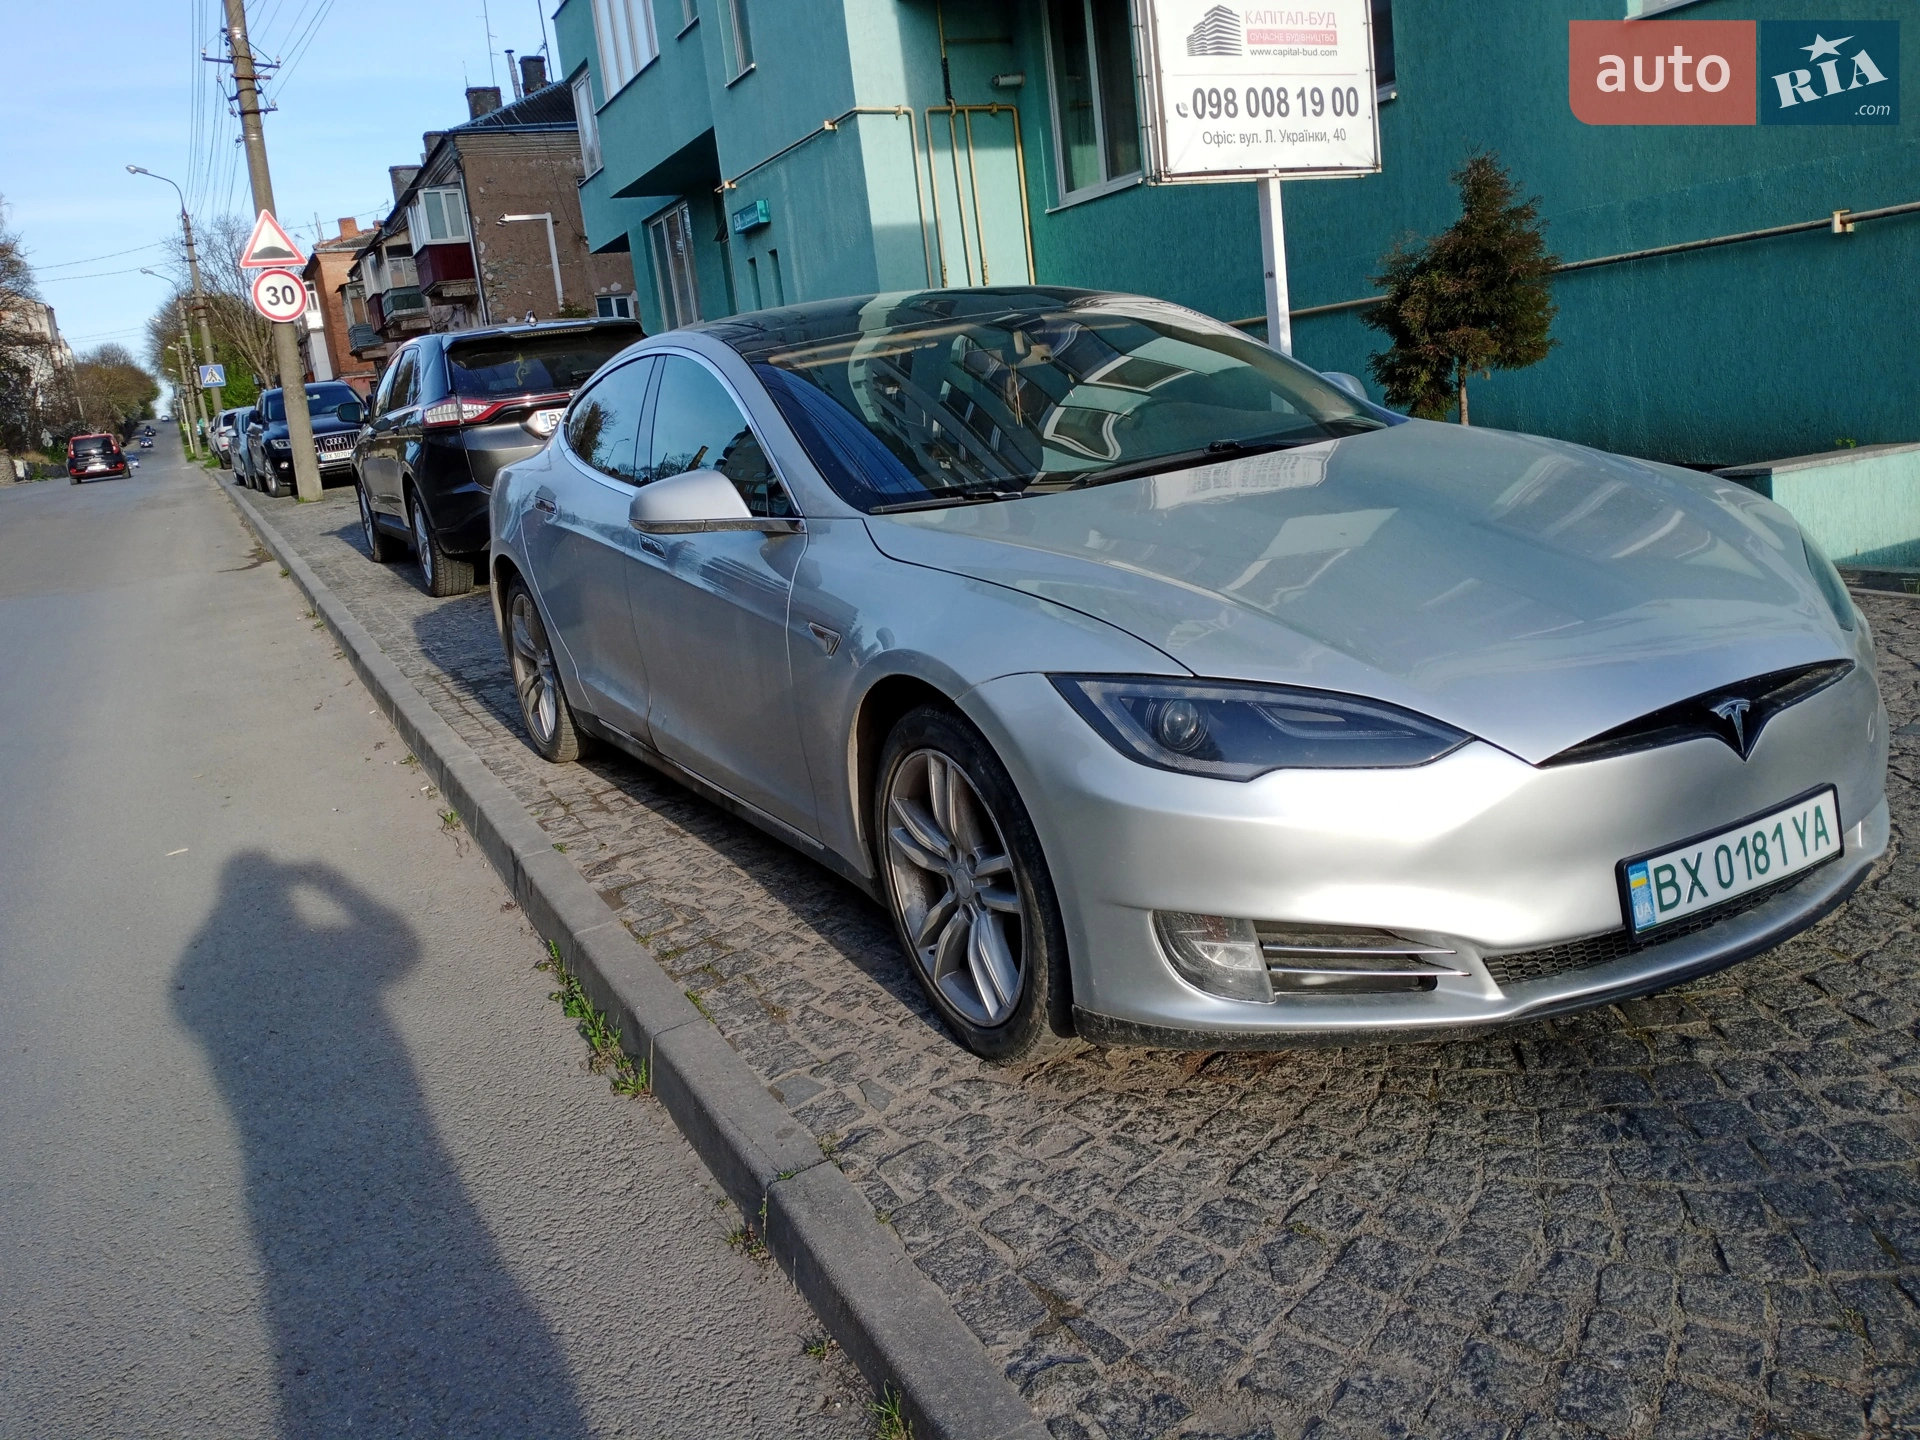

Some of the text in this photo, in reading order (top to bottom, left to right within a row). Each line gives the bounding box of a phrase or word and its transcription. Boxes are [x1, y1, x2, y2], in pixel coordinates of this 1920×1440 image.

[1245, 10, 1337, 28] КАПІТАЛ-БУД
[1249, 32, 1336, 44] СУЧАСНЕ БУДІВНИЦТВО
[1249, 47, 1338, 58] www.capital-bud.com
[1192, 86, 1360, 120] 098 008 19 00
[1202, 131, 1236, 148] Офіс:
[1239, 132, 1261, 147] вул.
[1279, 129, 1331, 146] Українки,
[1333, 128, 1347, 141] 40
[265, 285, 295, 306] 30
[548, 413, 562, 427] B
[1653, 804, 1831, 913] BX 0181 YA
[1635, 902, 1653, 919] UA
